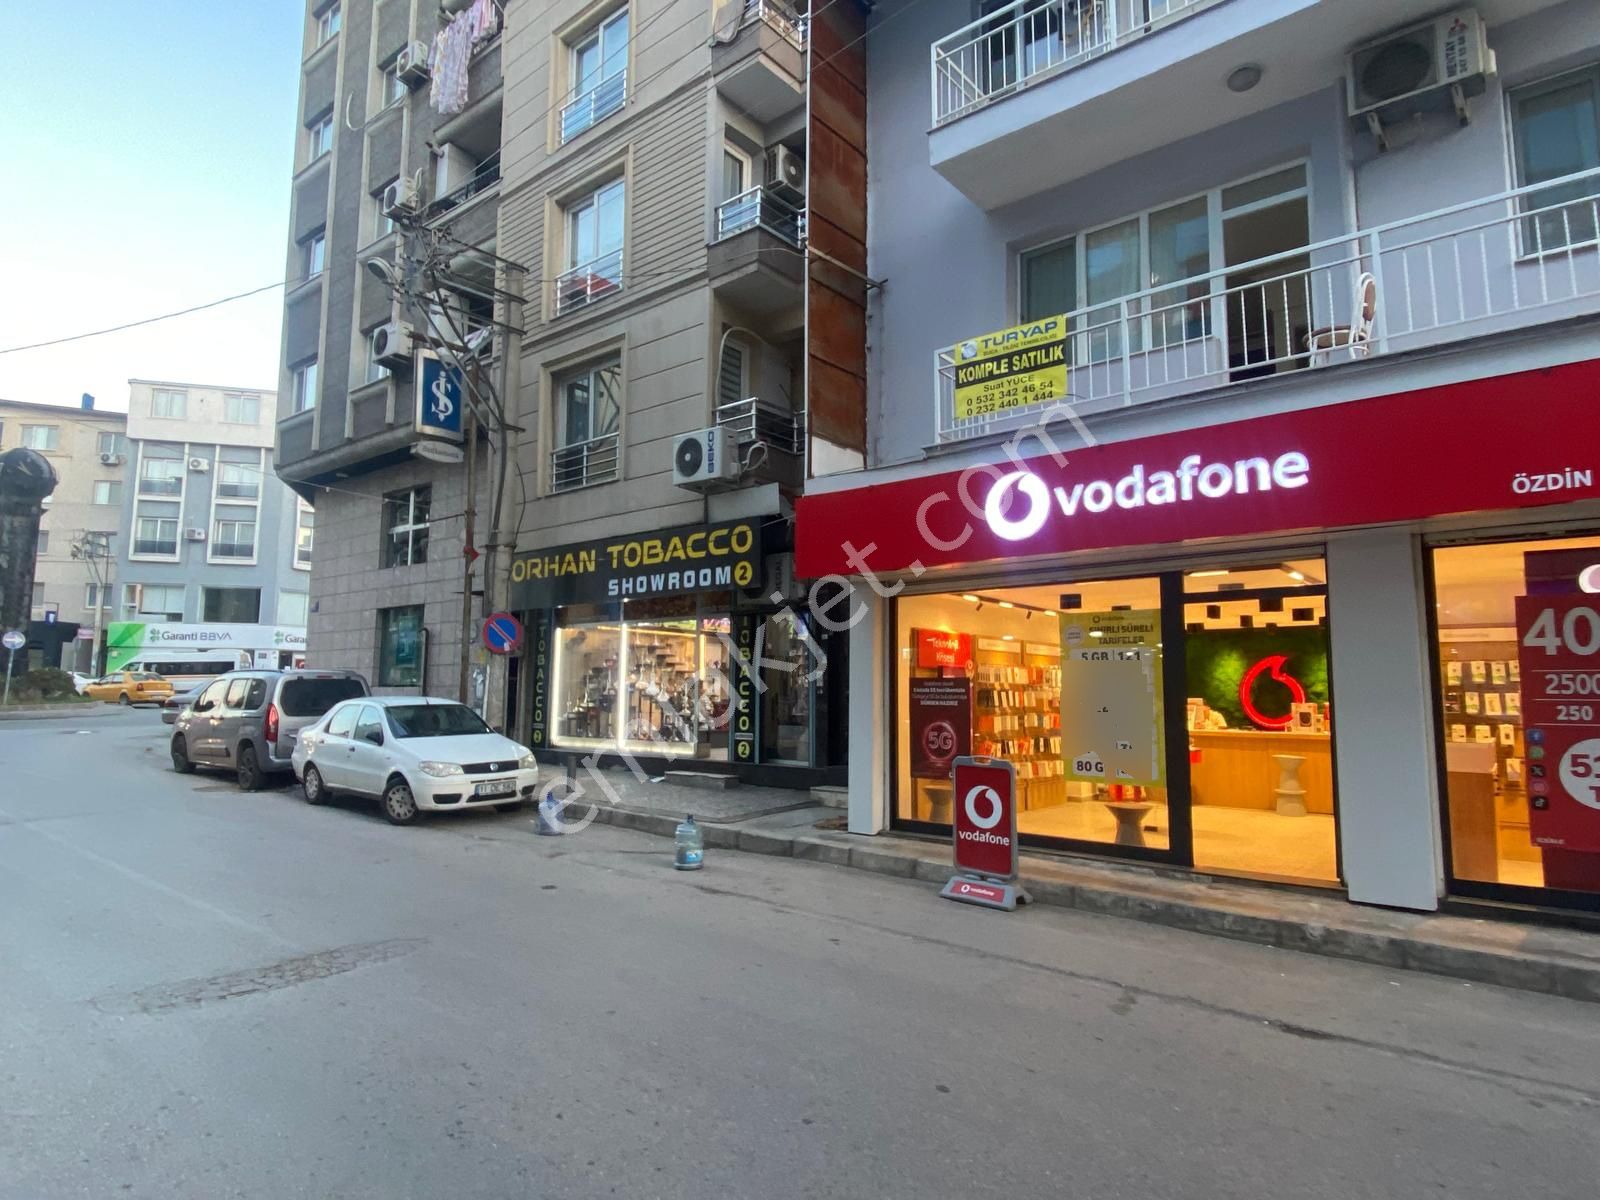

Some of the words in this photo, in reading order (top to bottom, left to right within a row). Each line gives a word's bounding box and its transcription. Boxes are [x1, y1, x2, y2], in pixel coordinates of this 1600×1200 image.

[981, 320, 1058, 349] TURYAP
[958, 358, 1009, 384] KOMPLE
[1012, 344, 1064, 371] SATILIK
[966, 398, 973, 406] 0
[976, 393, 995, 405] 532
[998, 387, 1018, 399] 342
[1021, 384, 1036, 394] 46
[1040, 380, 1053, 391] 54
[983, 380, 1004, 392] Suat
[1006, 374, 1035, 387] YÜCE
[966, 408, 973, 416] 0
[976, 403, 995, 415] 232
[998, 398, 1019, 409] 440
[1023, 396, 1028, 404] 1
[1032, 390, 1053, 401] 444
[707, 431, 715, 474] BEKO
[1054, 450, 1310, 516] vodafone
[1512, 467, 1592, 494] ÖZDİN
[511, 549, 596, 583] ORHAN
[606, 524, 753, 569] TOBACCO
[607, 565, 732, 596] SHOWROOM
[161, 630, 198, 641] Garanti
[199, 631, 232, 641] BBVA
[1523, 606, 1600, 656] 40
[1556, 705, 1593, 721] 250
[928, 731, 952, 750] 5G
[1076, 761, 1092, 771] 80
[958, 830, 1010, 846] vodafone
